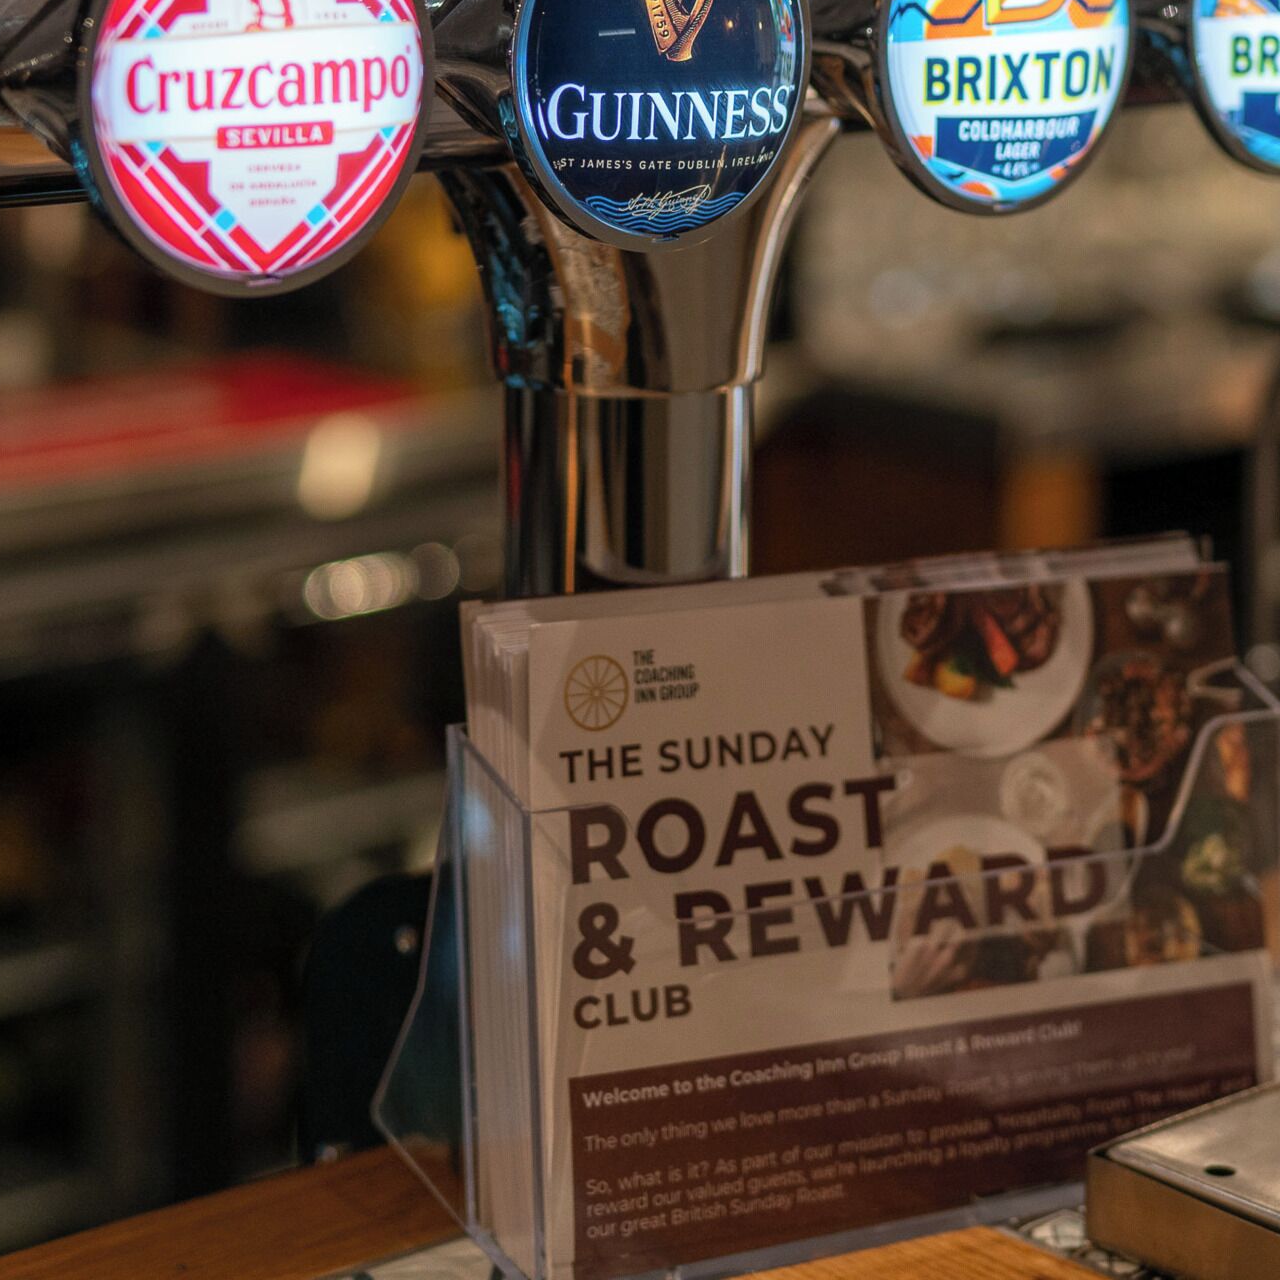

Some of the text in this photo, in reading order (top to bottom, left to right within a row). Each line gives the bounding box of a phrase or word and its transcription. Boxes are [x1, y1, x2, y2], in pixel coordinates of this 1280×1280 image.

[652, 5, 669, 38] 1759
[125, 53, 410, 114] Cruzcampo
[923, 45, 1115, 104] BRIXTON
[547, 83, 790, 141] GUINNESS
[958, 116, 1081, 141] COLDHARBOUR
[225, 125, 324, 147] SEVILLA
[994, 141, 1041, 161] LAGER
[580, 158, 633, 170] JAMES'S
[638, 160, 672, 170] GATE
[633, 649, 655, 666] THE
[634, 664, 695, 685] COACHING
[634, 682, 700, 704] INN GROUP
[560, 724, 835, 784] THE SUNDAY
[569, 775, 897, 885] ROAST
[572, 845, 1107, 980] & REWARD
[572, 983, 693, 1030] CLUB
[582, 1083, 670, 1108] Welcome
[673, 1079, 693, 1095] to
[695, 1074, 727, 1092] the
[729, 1059, 814, 1087] Coaching
[816, 1057, 846, 1074] Inn
[848, 1049, 903, 1070] Group
[584, 1133, 618, 1152] The
[620, 1127, 658, 1147] only
[661, 1121, 708, 1140] thing
[710, 1117, 736, 1133] we
[739, 1109, 774, 1128] love
[777, 1104, 823, 1120] more
[825, 1097, 866, 1116] than
[586, 1178, 612, 1197] So,
[618, 1171, 662, 1191] what
[668, 1166, 683, 1183] is
[688, 1160, 711, 1179] it?
[716, 1158, 737, 1175] As
[741, 1151, 778, 1174] part
[780, 1145, 801, 1165] of
[803, 1145, 833, 1162] our
[586, 1194, 649, 1218] reward
[652, 1190, 682, 1207] our
[686, 1178, 745, 1201] valued
[586, 1222, 616, 1239] our
[621, 1212, 667, 1237] great
[671, 1202, 727, 1226] British
[730, 1192, 794, 1216] Sunday
